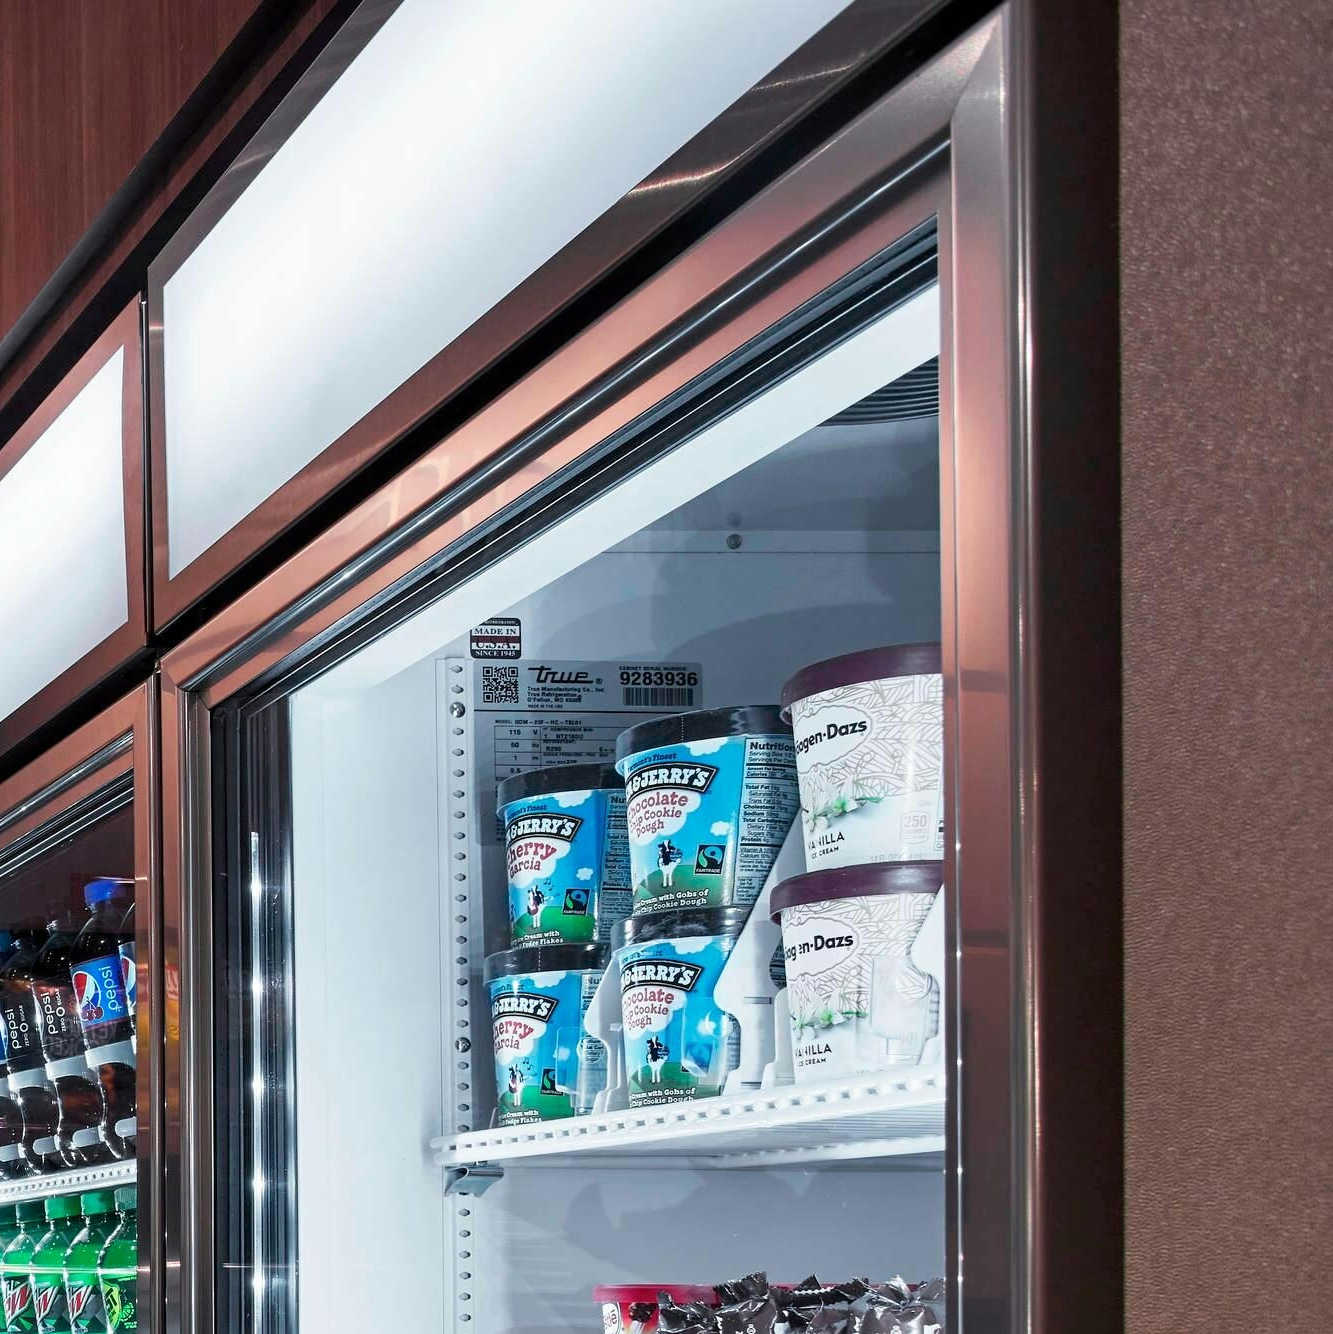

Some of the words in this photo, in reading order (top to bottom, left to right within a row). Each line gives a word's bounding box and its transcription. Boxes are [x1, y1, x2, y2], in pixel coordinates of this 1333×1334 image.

[528, 665, 594, 684] true
[619, 671, 698, 686] 9283936
[749, 742, 795, 752] Nutrition
[652, 752, 678, 761] Finest
[640, 766, 710, 790] JERRY'S
[527, 804, 548, 812] Finest
[644, 807, 683, 821] Cookie
[516, 818, 576, 837] JERRY'S
[636, 819, 665, 838] Dough
[903, 815, 927, 828] 250
[819, 846, 840, 856] CREAM
[658, 892, 675, 901] with
[675, 889, 698, 899] Gobs
[653, 902, 679, 911] Cookie
[680, 897, 708, 908] Dough
[632, 964, 695, 986] JERRY'S
[98, 964, 124, 1013] pepsi
[43, 991, 60, 1036] pepsi
[498, 997, 551, 1017] JERRY'S
[634, 1003, 669, 1016] Cookie
[4, 1008, 23, 1051] pepsi
